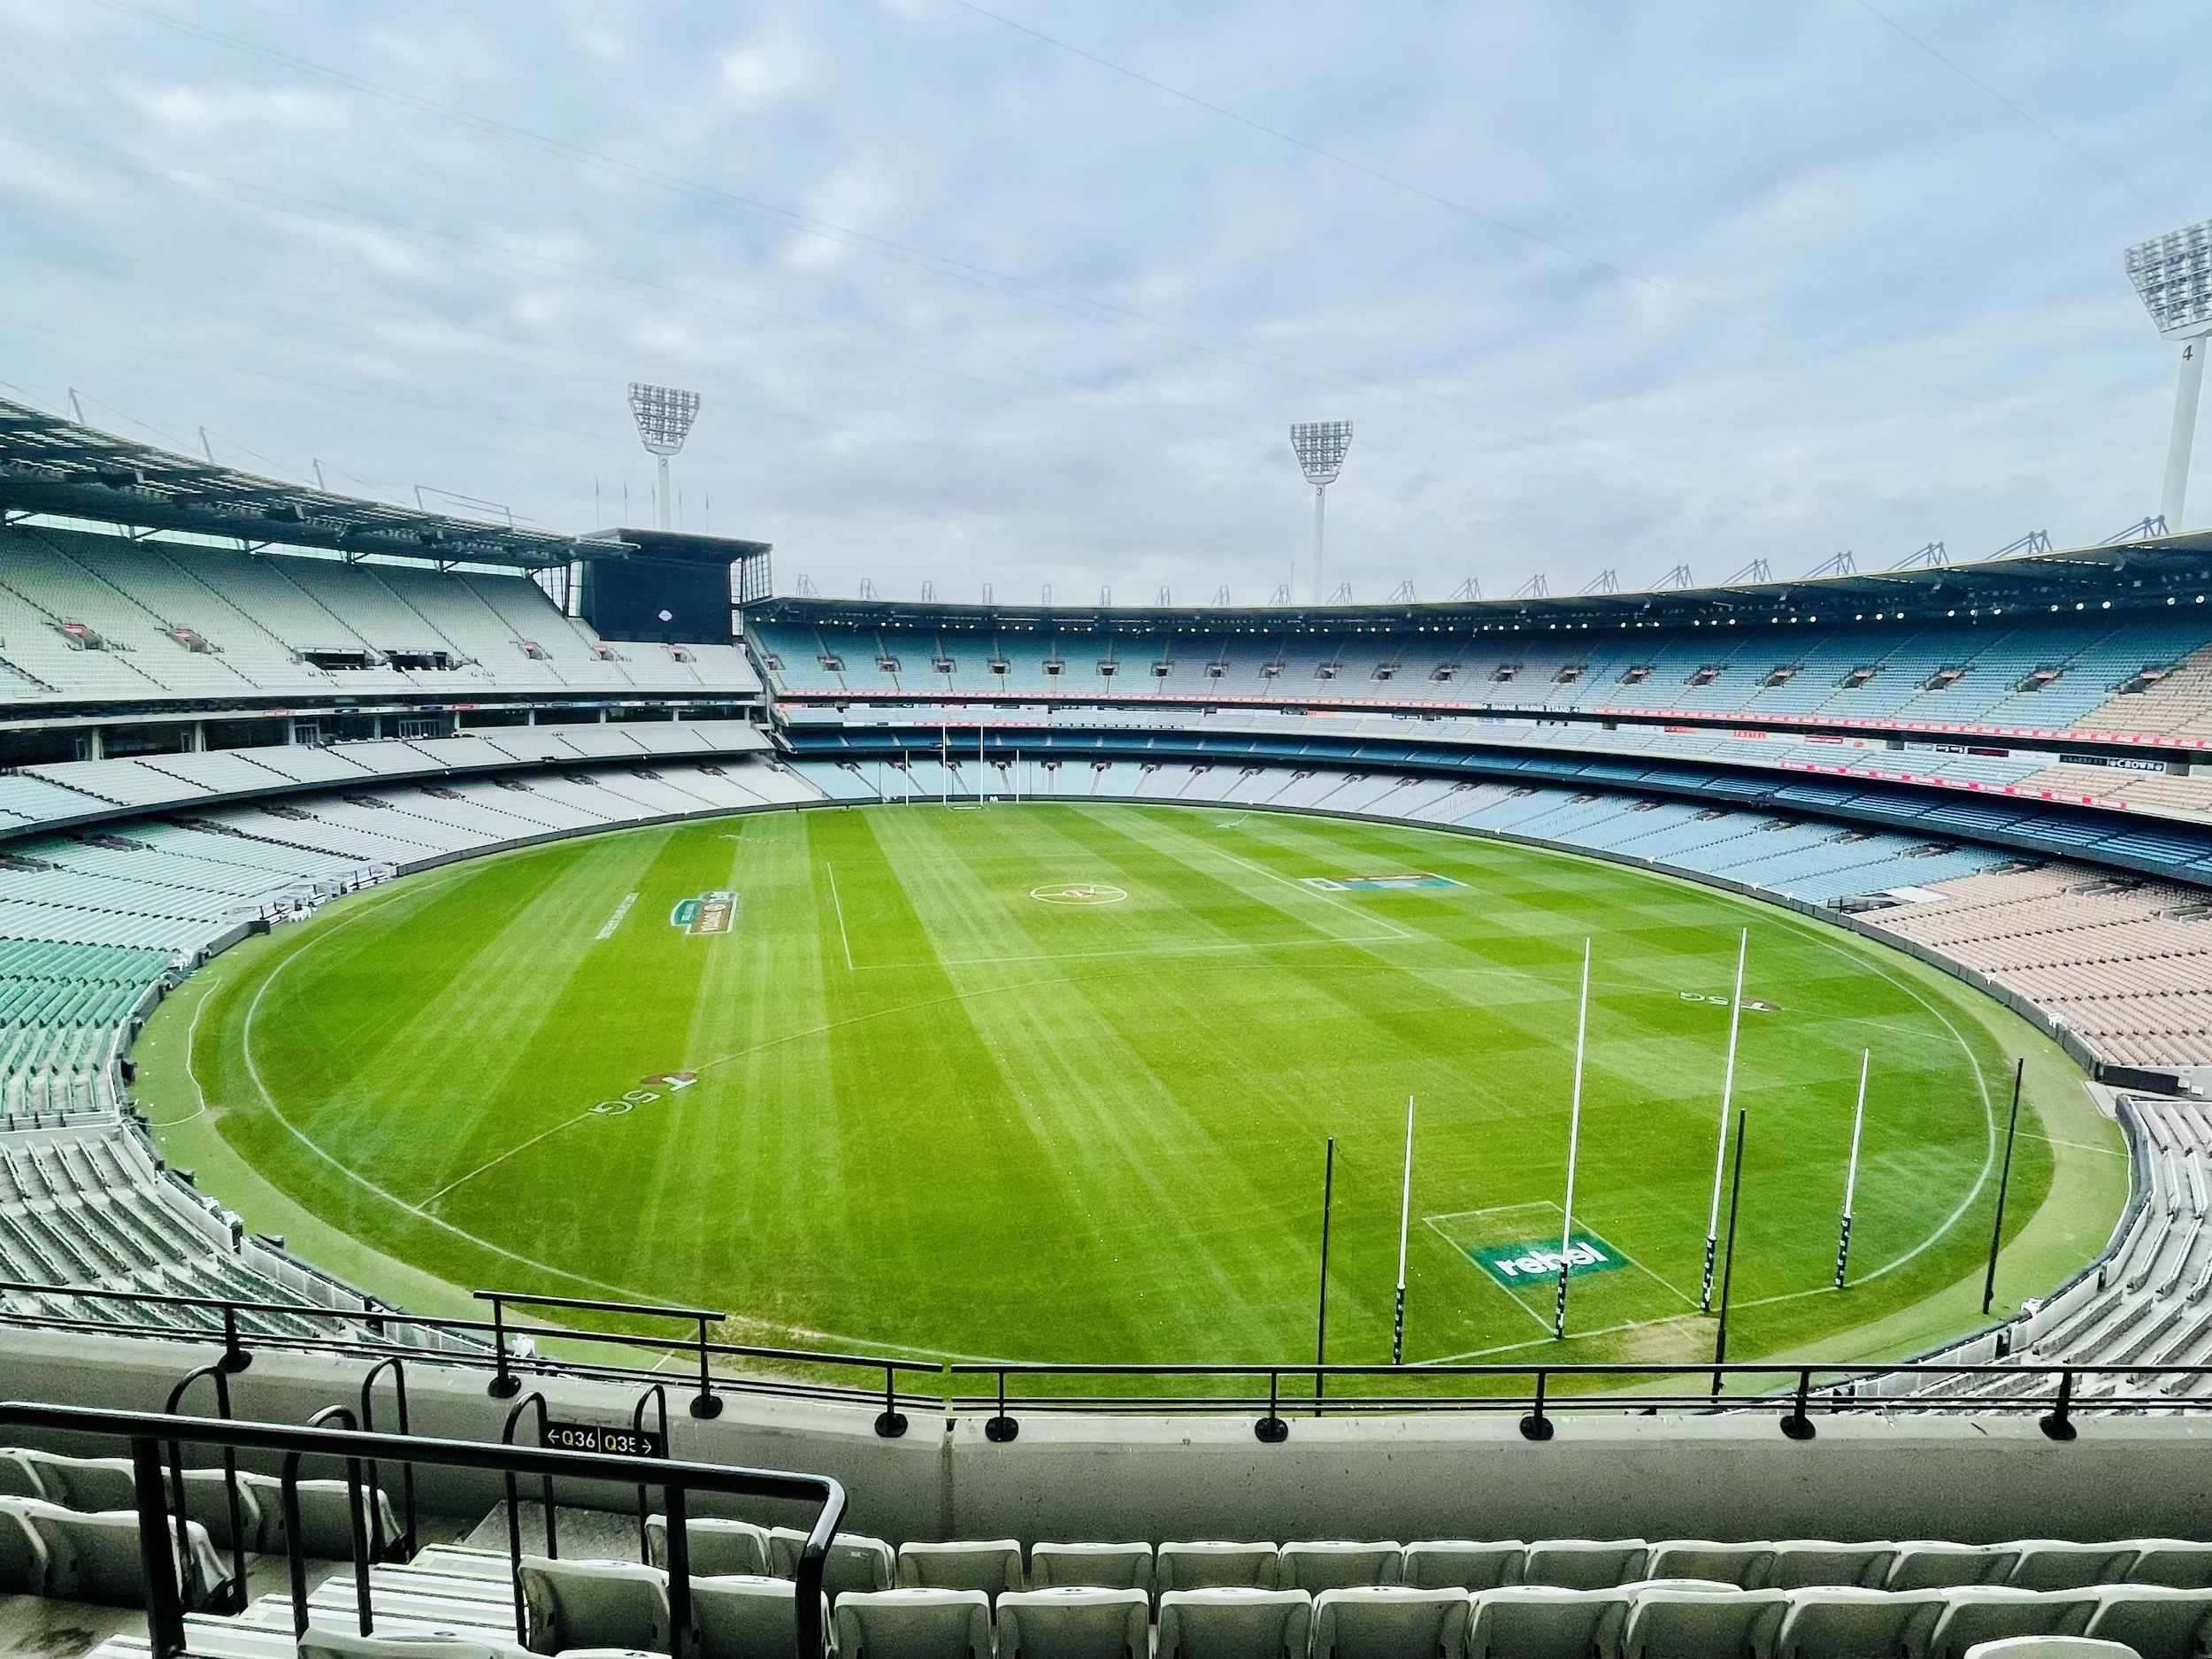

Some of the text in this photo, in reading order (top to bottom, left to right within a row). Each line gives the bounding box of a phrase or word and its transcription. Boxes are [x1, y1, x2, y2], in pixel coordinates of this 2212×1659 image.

[2182, 345, 2193, 361] 4
[2116, 760, 2154, 770] CROWN
[1494, 1241, 1609, 1277] rebel
[562, 1430, 637, 1453] Q36 Q35
